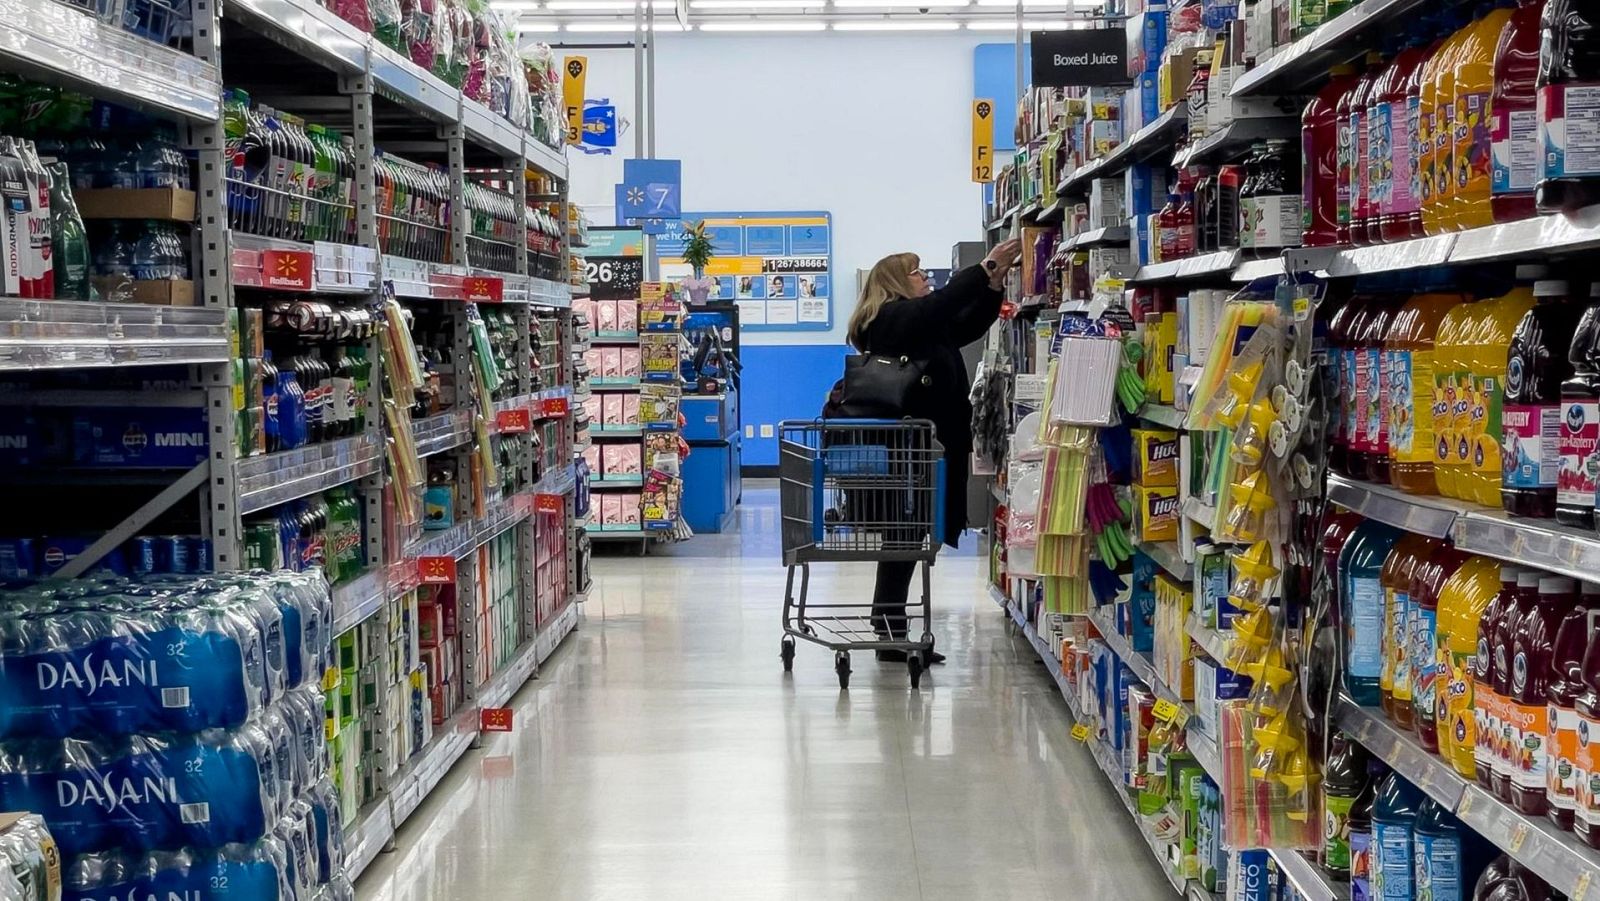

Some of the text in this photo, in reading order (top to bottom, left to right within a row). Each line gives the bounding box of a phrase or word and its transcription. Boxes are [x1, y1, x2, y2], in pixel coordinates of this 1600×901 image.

[1053, 52, 1118, 66] Boxed Juice
[567, 106, 577, 121] F
[569, 126, 578, 141] 3
[977, 145, 988, 161] F
[975, 166, 990, 180] 12
[655, 187, 669, 210] 7
[655, 233, 670, 241] we
[586, 262, 613, 283] 26
[269, 277, 304, 287] Rollback
[0, 435, 28, 448] INI
[154, 432, 204, 447] MINI
[166, 643, 185, 656] 32
[37, 652, 158, 696] DASANI
[185, 760, 203, 773] 32
[57, 770, 178, 814] DASANI
[46, 846, 58, 866] 3
[210, 876, 228, 889] 32
